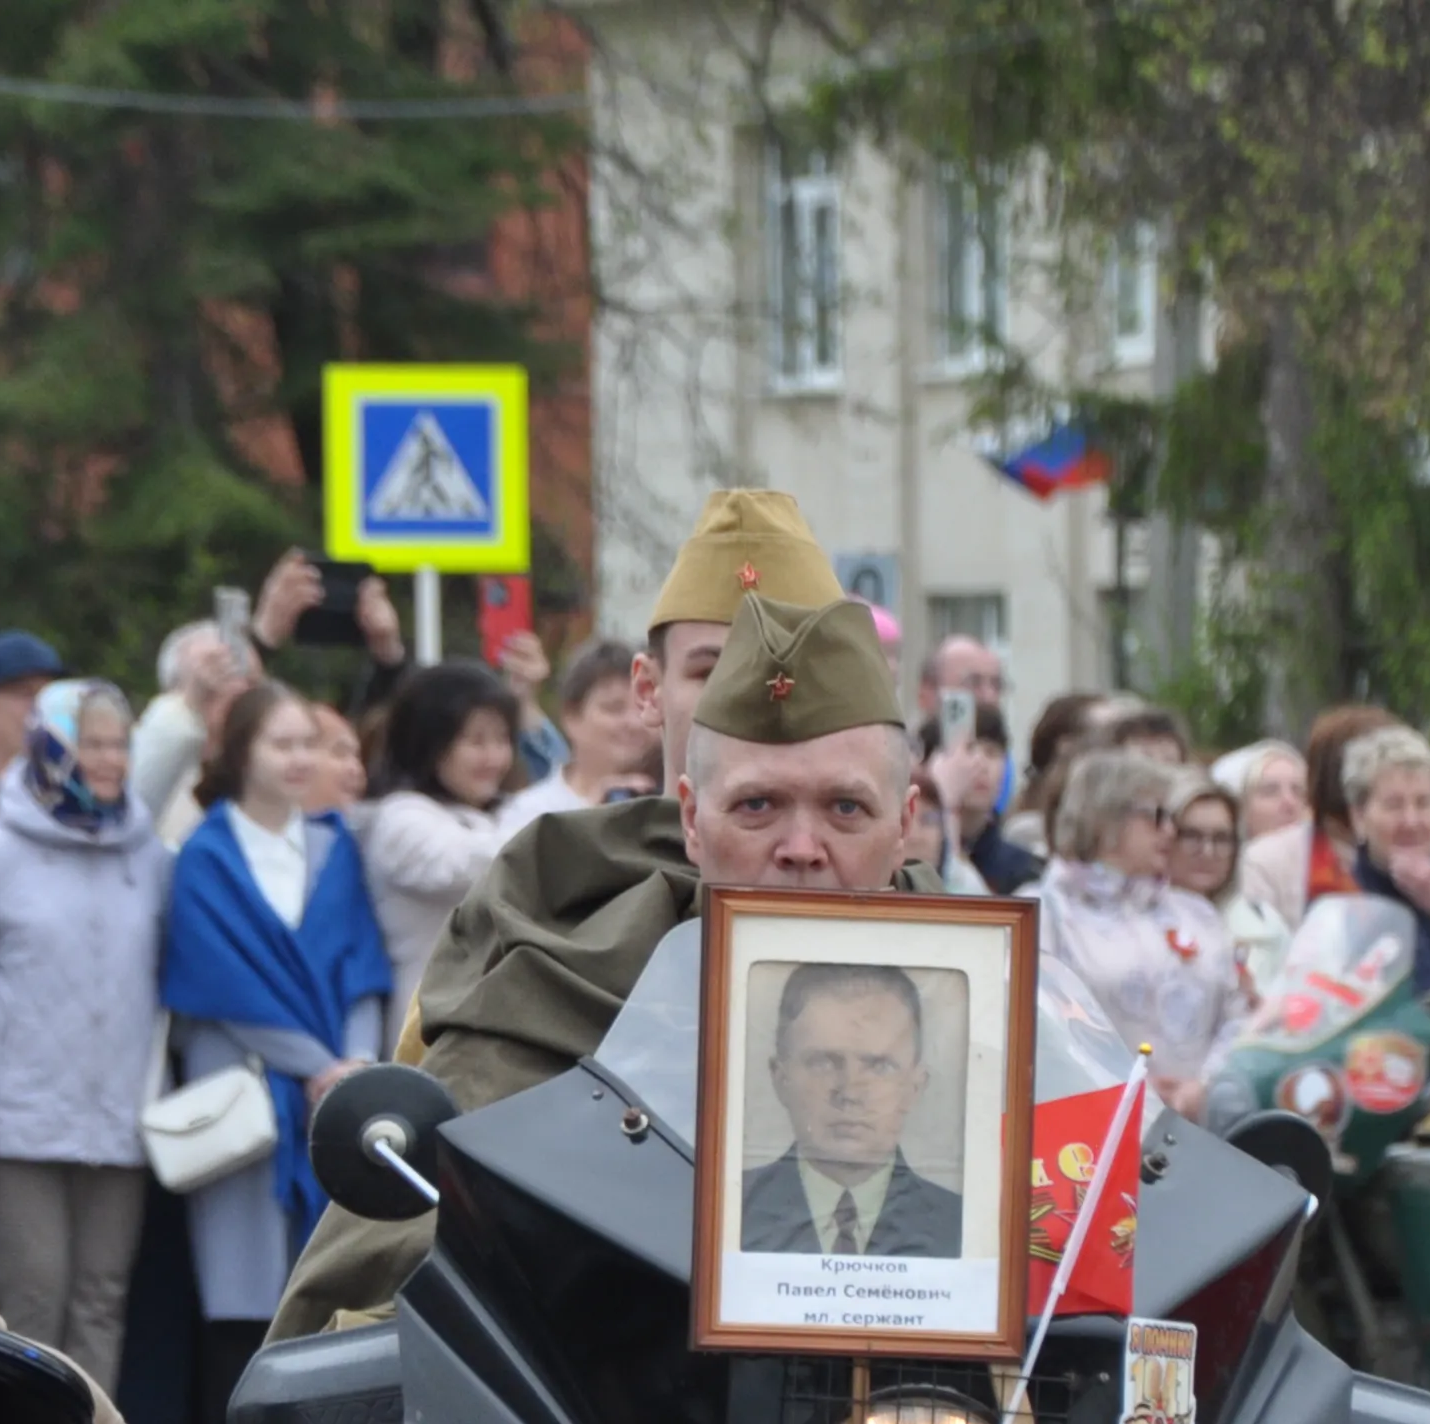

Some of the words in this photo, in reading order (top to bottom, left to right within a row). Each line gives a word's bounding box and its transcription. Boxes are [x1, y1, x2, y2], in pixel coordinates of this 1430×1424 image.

[820, 1257, 909, 1274] Крючков
[777, 1282, 837, 1298] Павел
[843, 1283, 952, 1301] Семёнович
[803, 1310, 836, 1325] мл.
[841, 1311, 925, 1328] сержант
